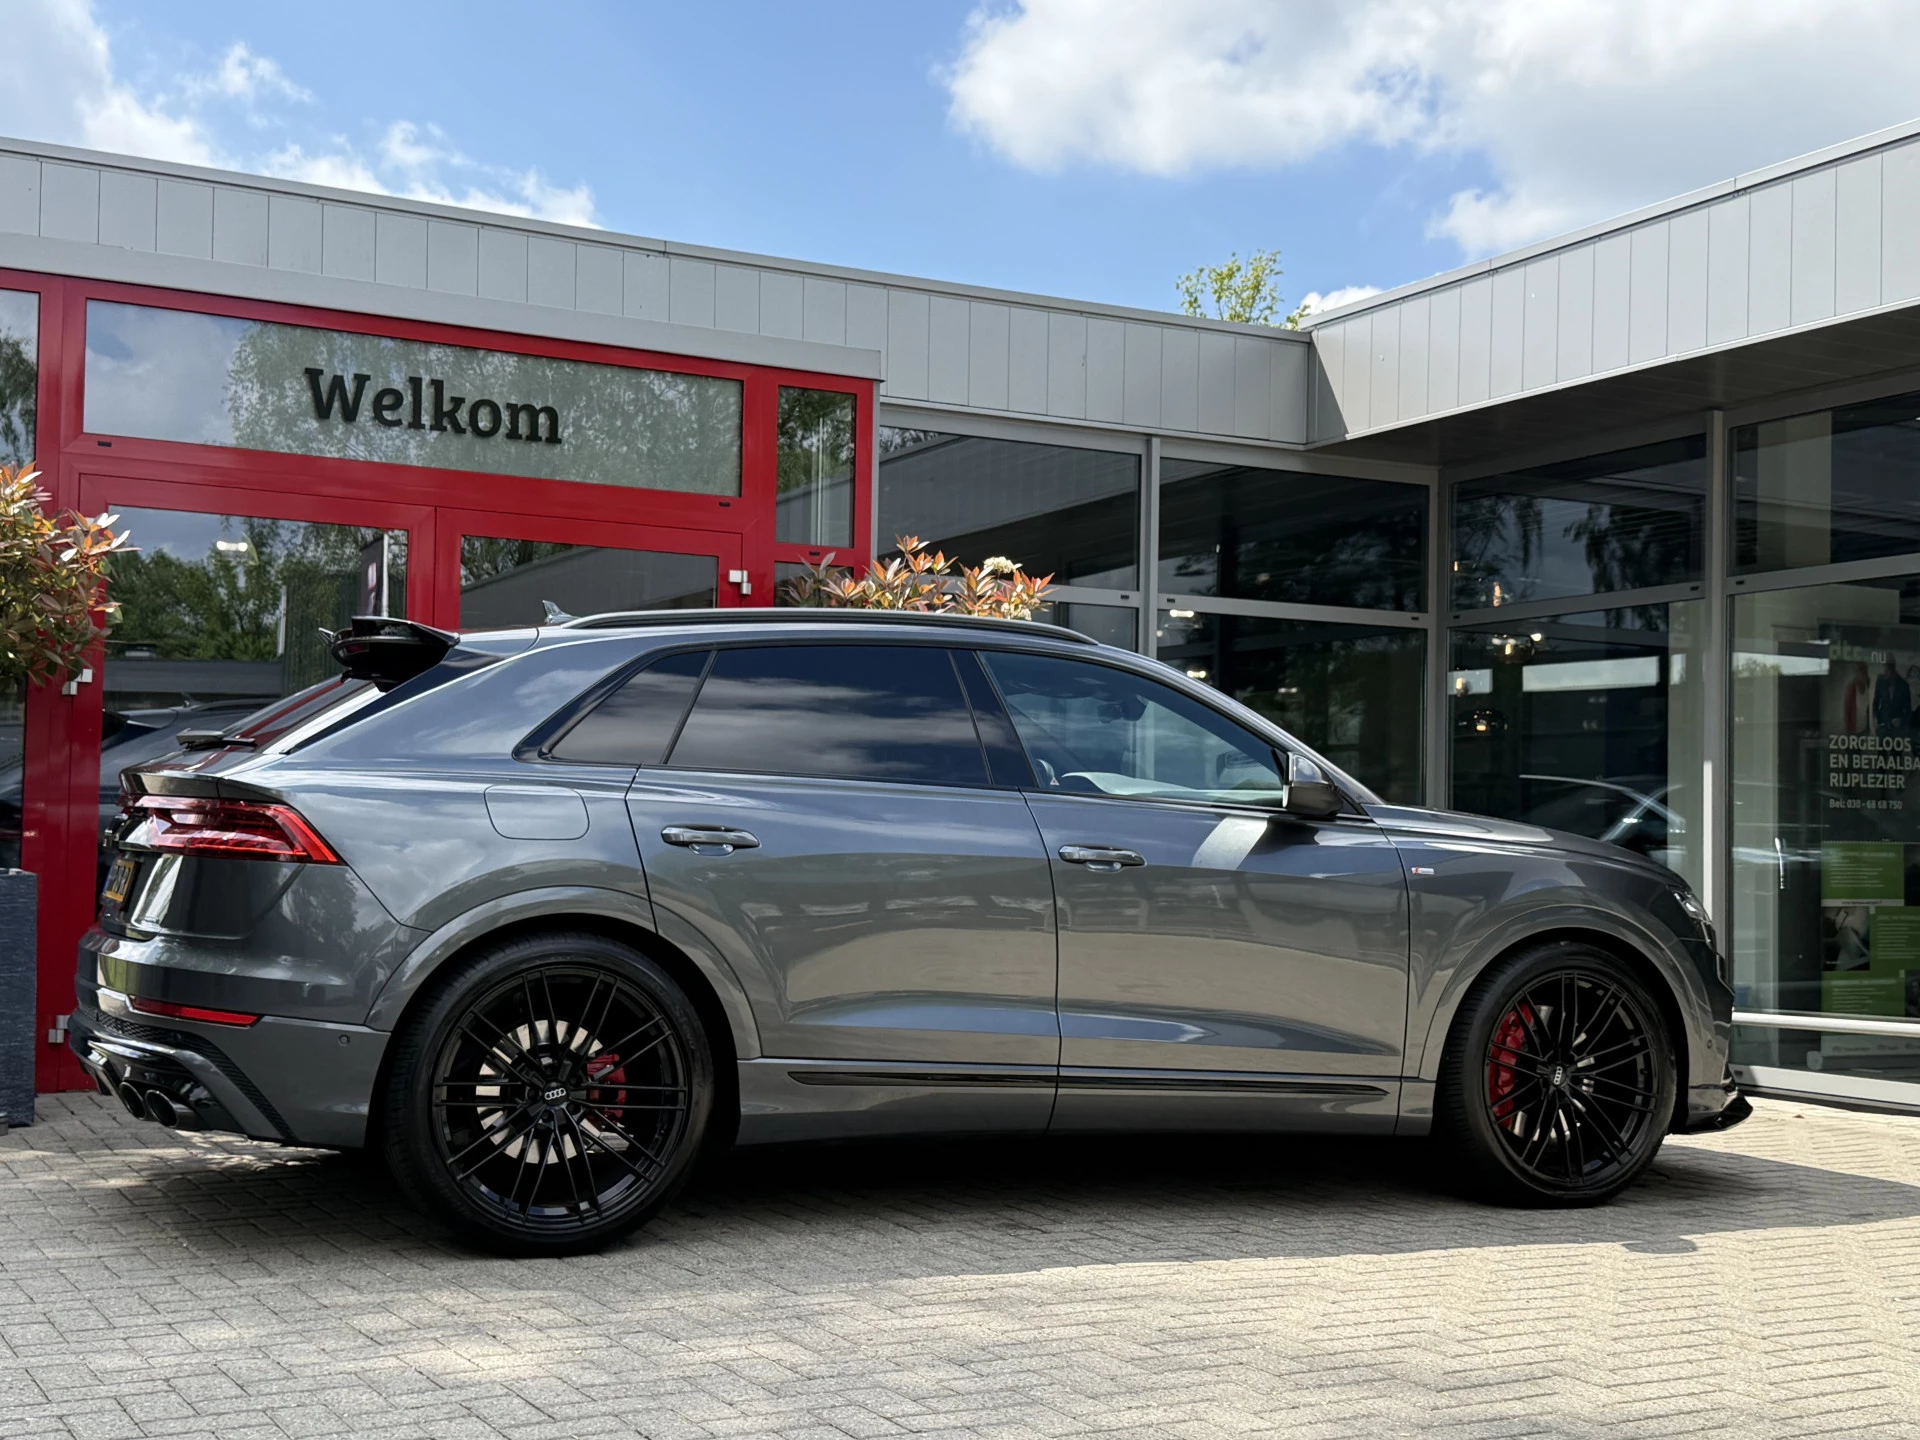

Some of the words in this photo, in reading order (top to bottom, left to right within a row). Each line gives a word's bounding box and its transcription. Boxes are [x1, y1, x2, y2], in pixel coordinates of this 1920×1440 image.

[304, 367, 562, 444] Welkom
[1829, 735, 1912, 752] ZORGELOOS
[1829, 753, 1849, 769] EN
[1829, 772, 1905, 789] RIJPLEZIER
